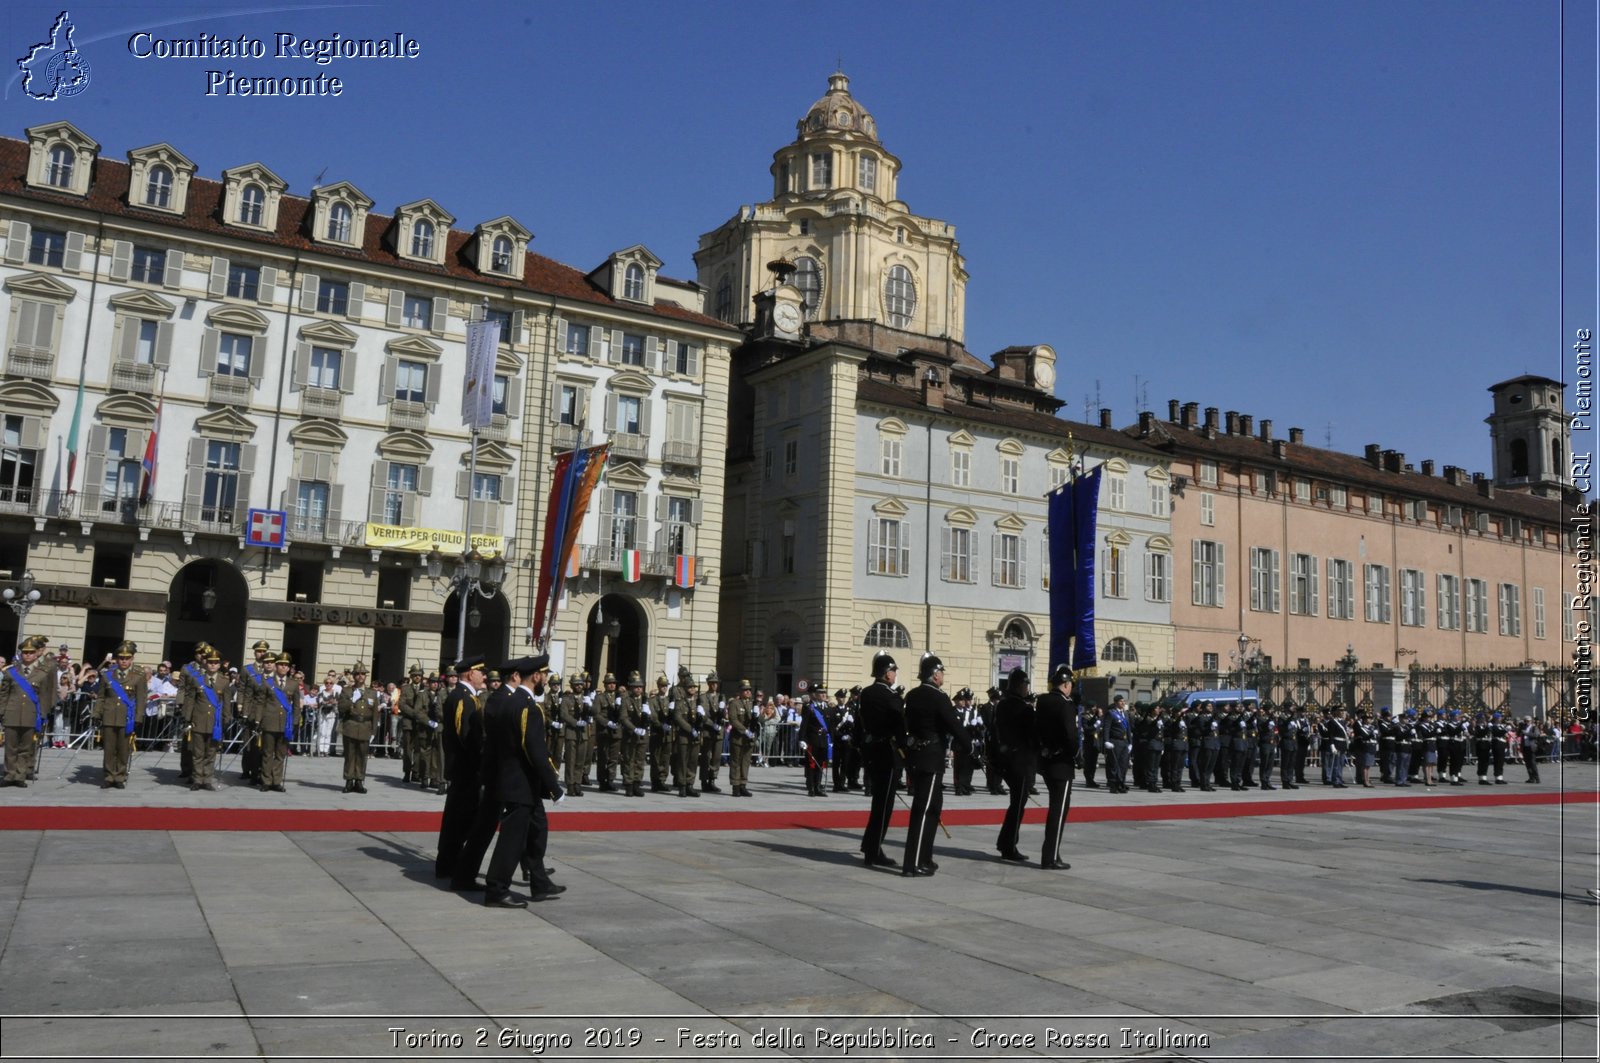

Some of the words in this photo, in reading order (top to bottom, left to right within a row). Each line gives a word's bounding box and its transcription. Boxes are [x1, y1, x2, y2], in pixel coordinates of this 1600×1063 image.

[410, 530, 428, 541] PER
[431, 532, 462, 545] GIULIO
[466, 536, 498, 548] EGENI
[292, 606, 404, 627] REGIONE
